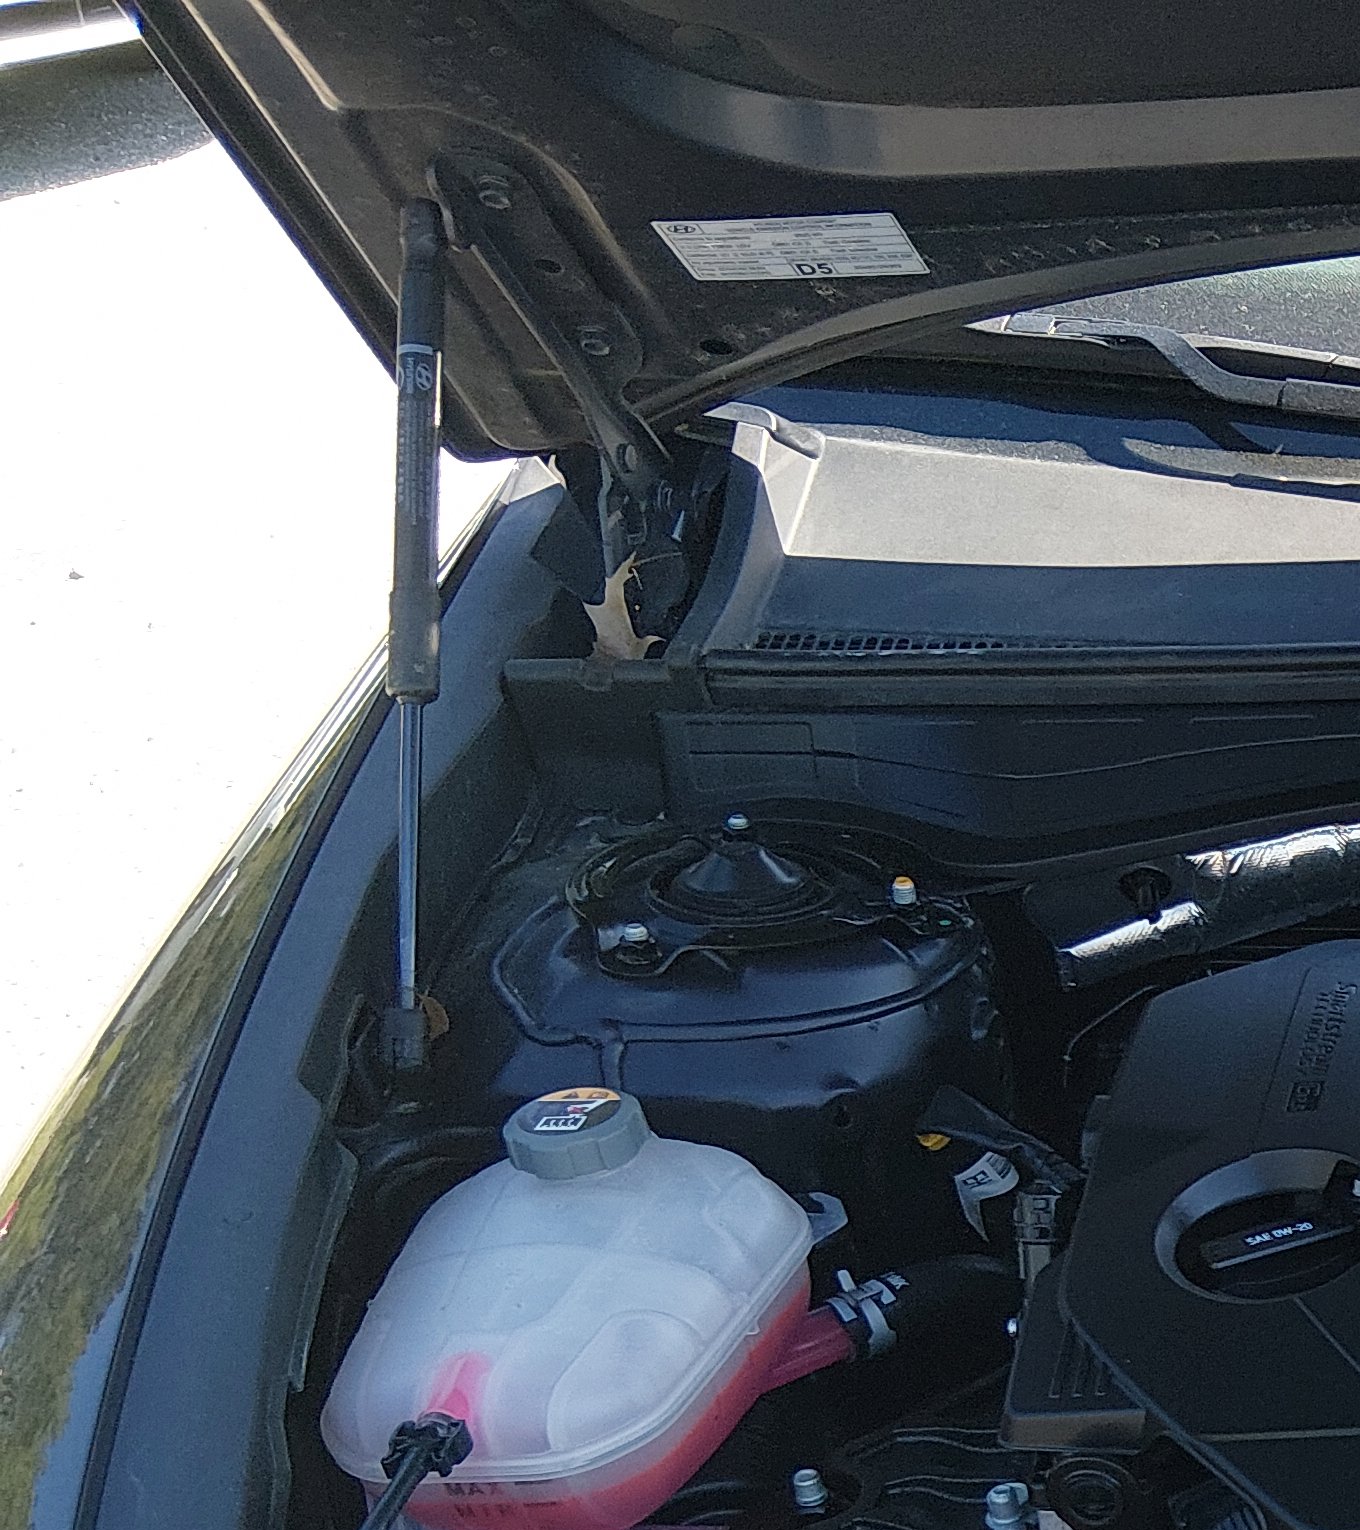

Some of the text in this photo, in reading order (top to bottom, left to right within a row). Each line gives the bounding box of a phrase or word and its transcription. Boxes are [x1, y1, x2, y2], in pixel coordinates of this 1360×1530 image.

[799, 262, 834, 276] D5
[1244, 1222, 1314, 1246] SAE 0W-20
